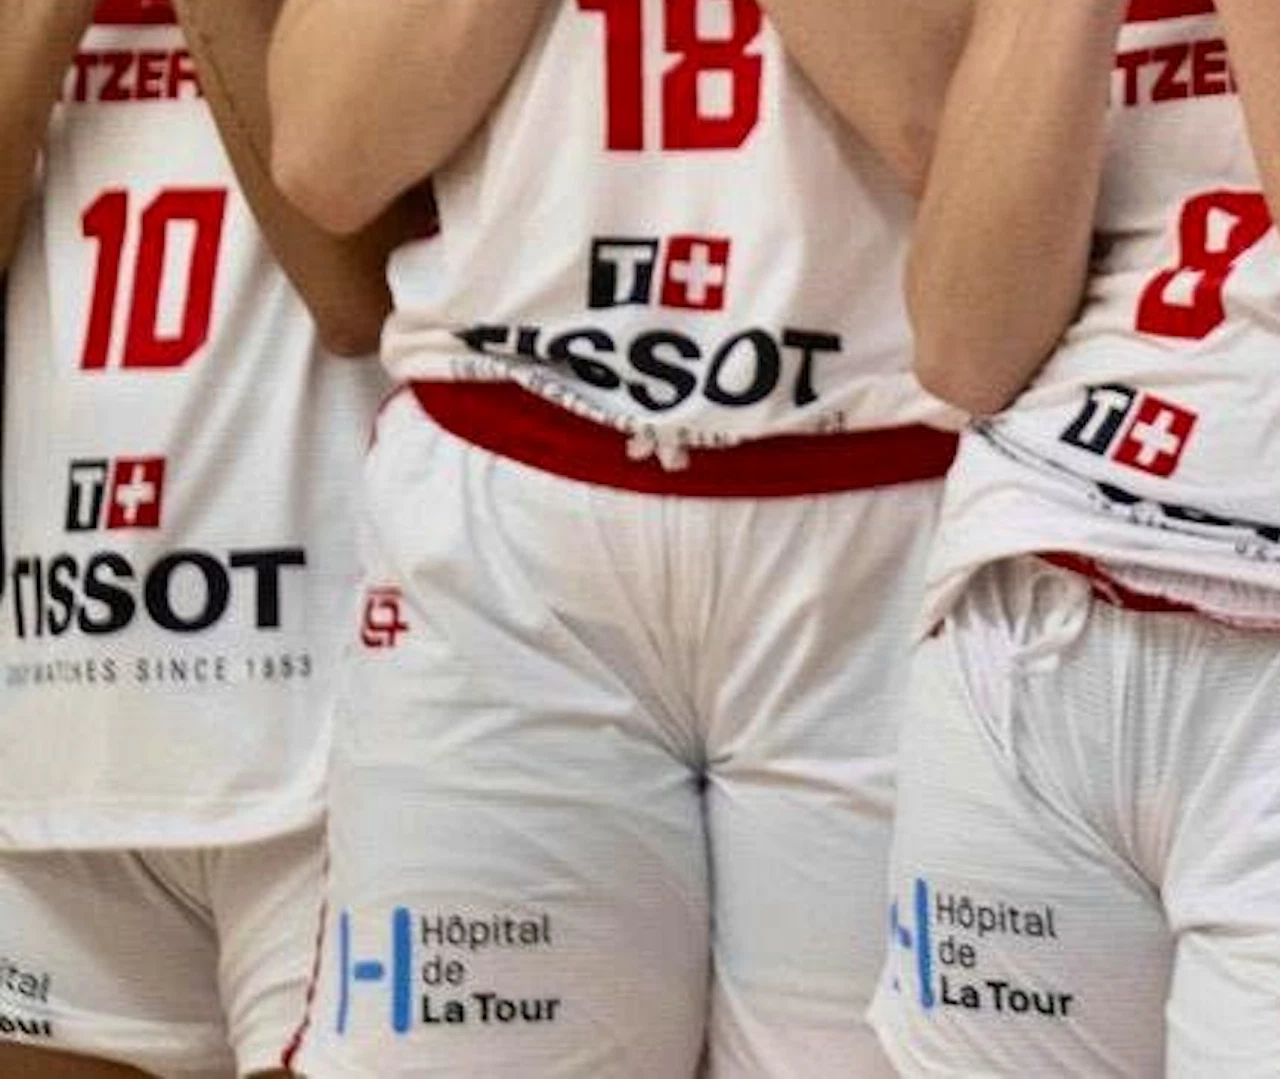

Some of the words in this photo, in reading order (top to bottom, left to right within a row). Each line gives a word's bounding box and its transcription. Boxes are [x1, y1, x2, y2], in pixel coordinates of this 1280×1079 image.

[80, 187, 228, 371] 10
[1135, 188, 1275, 340] 8
[12, 547, 307, 639] TISSOT
[136, 656, 225, 683] SINCE
[247, 653, 313, 680] 1853
[420, 913, 551, 950] Hôpital
[934, 892, 1057, 940] Hôpital
[421, 953, 465, 985] de
[938, 937, 977, 969] de
[421, 995, 466, 1024] La
[478, 992, 561, 1024] Tour
[940, 976, 980, 1009] La
[985, 981, 1075, 1017] Tour
